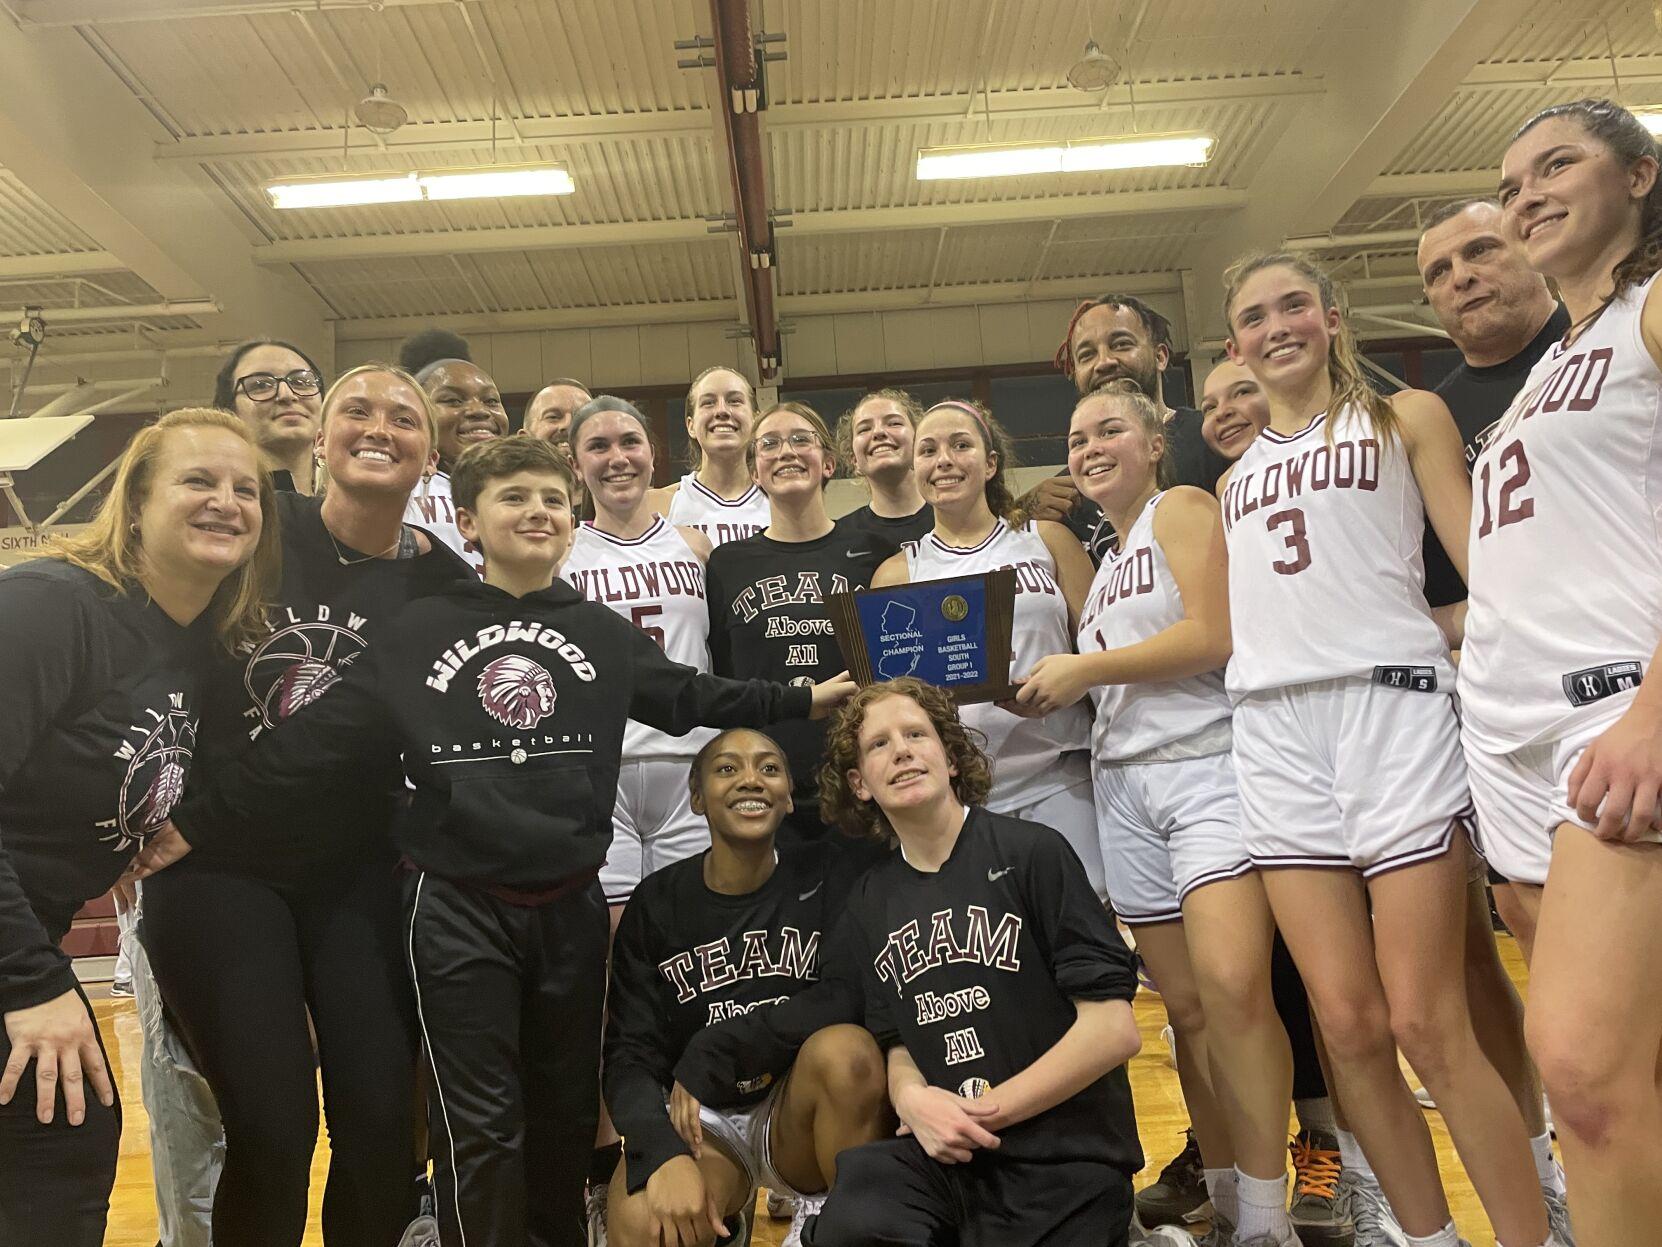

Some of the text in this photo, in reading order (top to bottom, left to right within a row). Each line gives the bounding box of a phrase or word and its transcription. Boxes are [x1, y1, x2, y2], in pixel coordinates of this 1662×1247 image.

[1224, 438, 1380, 534] WILDWOOD
[1479, 439, 1535, 539] 12
[1, 536, 37, 549] SIXTH
[1265, 507, 1312, 575] 3
[570, 561, 705, 603] WILDWOOD
[631, 604, 665, 653] 5
[880, 630, 922, 643] SECTIONAL
[947, 633, 966, 643] GIRLS
[425, 620, 597, 693] WILDWOOD
[785, 644, 819, 666] All
[883, 645, 924, 657] CHAMPION
[938, 642, 978, 654] BASKETBALL
[948, 652, 970, 661] SOUTH
[945, 670, 979, 681] 2021-2022
[947, 662, 968, 672] GROUP
[1418, 678, 1428, 689] S
[1616, 676, 1635, 692] M
[431, 733, 593, 753] basketball
[875, 905, 1022, 1000] TEAM
[658, 926, 822, 1004] TEAM
[914, 985, 991, 1026] Above
[943, 1026, 985, 1066] All
